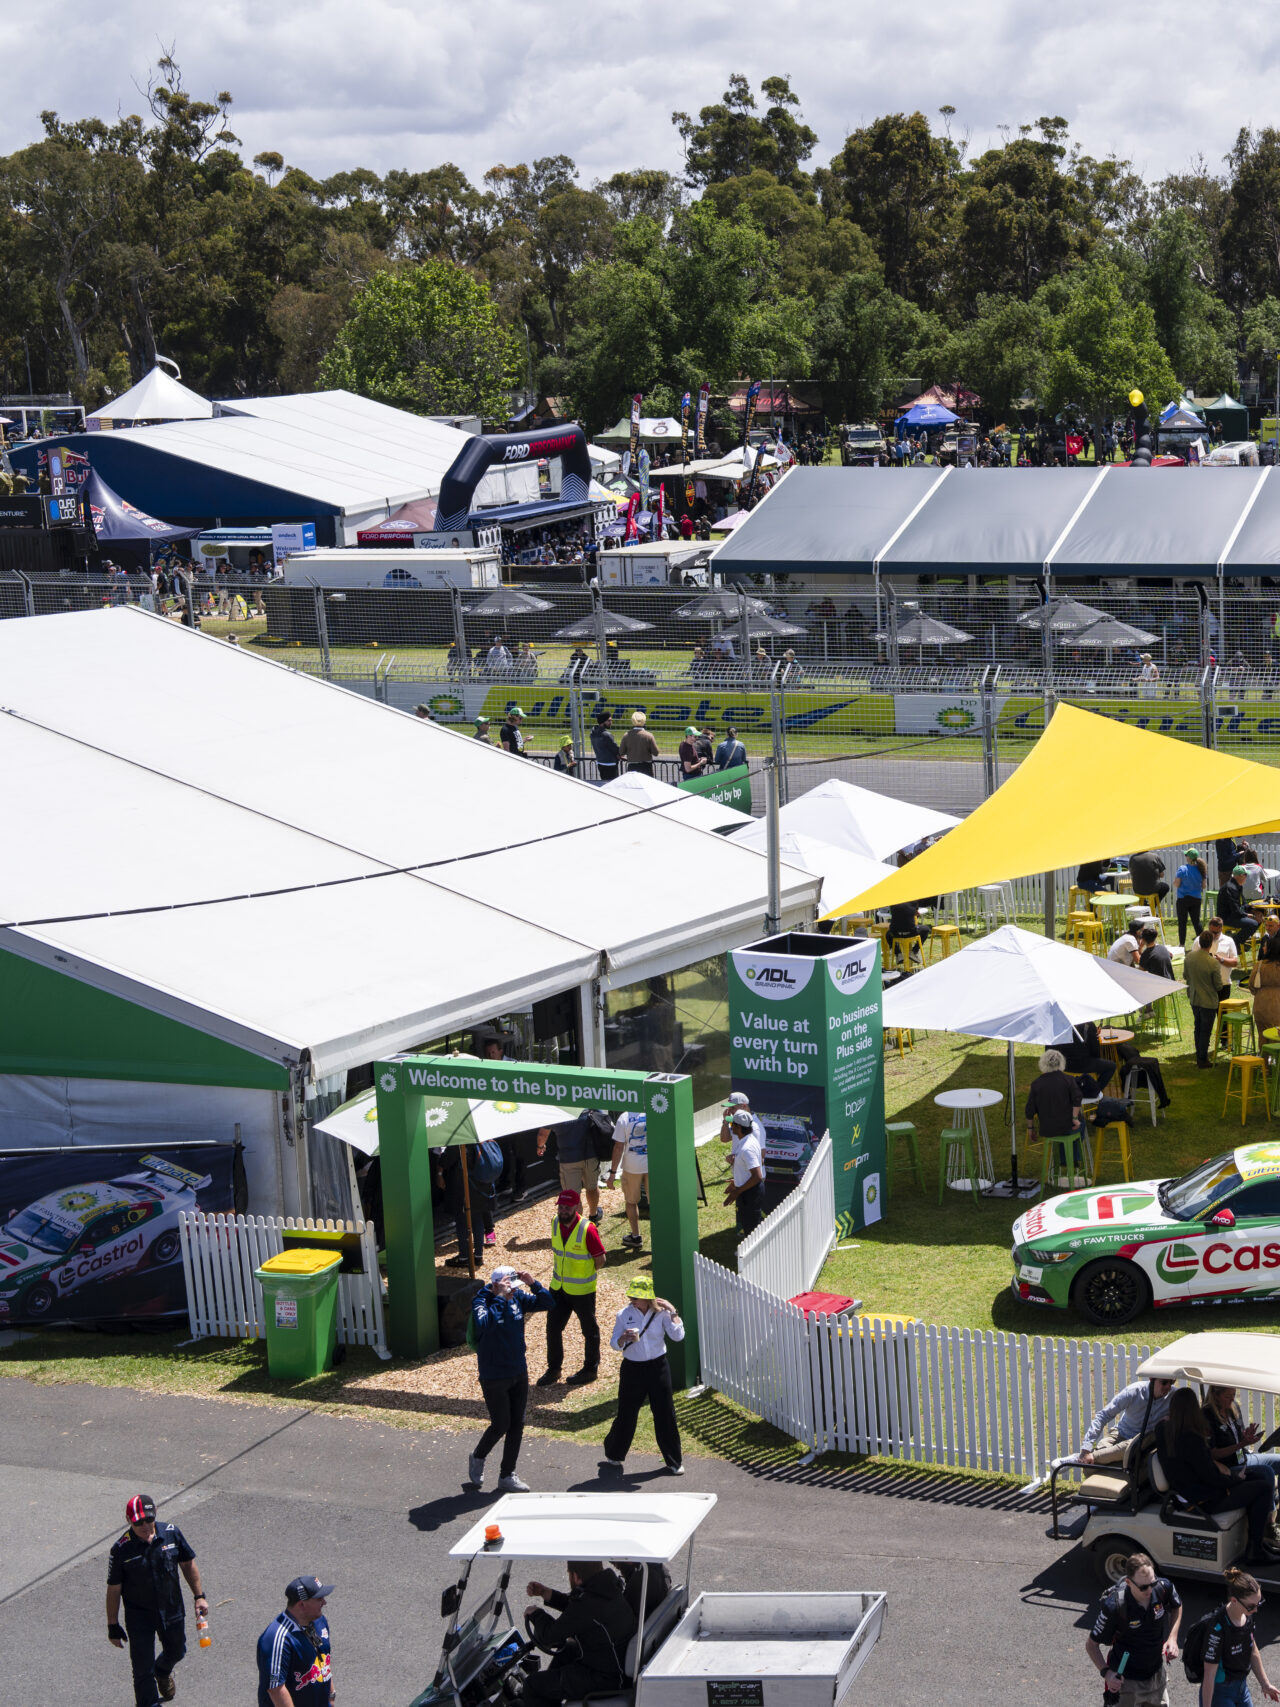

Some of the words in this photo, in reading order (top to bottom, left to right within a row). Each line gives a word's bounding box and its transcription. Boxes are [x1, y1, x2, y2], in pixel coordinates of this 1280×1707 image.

[503, 443, 530, 461] FORD
[529, 434, 576, 456] PERFORMANCE
[58, 498, 76, 508] QUAD
[60, 508, 77, 520] LOCK
[504, 695, 766, 723] ultimate
[724, 790, 733, 802] by
[733, 787, 742, 800] bp
[756, 968, 796, 983] ADL
[842, 959, 867, 980] ADL
[740, 1012, 789, 1032] Value
[793, 1019, 810, 1034] at
[829, 1016, 842, 1030] Do
[842, 1002, 879, 1021] business
[841, 1030, 852, 1041] on
[853, 1023, 868, 1037] the
[733, 1036, 778, 1055] every
[782, 1038, 818, 1055] turn
[836, 1045, 855, 1060] Plus
[855, 1036, 873, 1052] side
[744, 1055, 782, 1072] with
[787, 1057, 809, 1079] bp
[408, 1068, 488, 1092] Welcome
[490, 1077, 509, 1093] to
[512, 1077, 541, 1096] the
[545, 1079, 568, 1101] bp
[571, 1082, 639, 1103] pavilion
[845, 1101, 857, 1118] bp
[142, 1156, 199, 1184] ultimate
[843, 1152, 870, 1172] ampm
[38, 1207, 54, 1220] FAW
[53, 1214, 83, 1231] TRUCKS
[1212, 1216, 1231, 1225] RYCO
[1084, 1236, 1106, 1245] FAW
[1108, 1233, 1145, 1242] TRUCKS
[76, 1233, 144, 1279] Castrol
